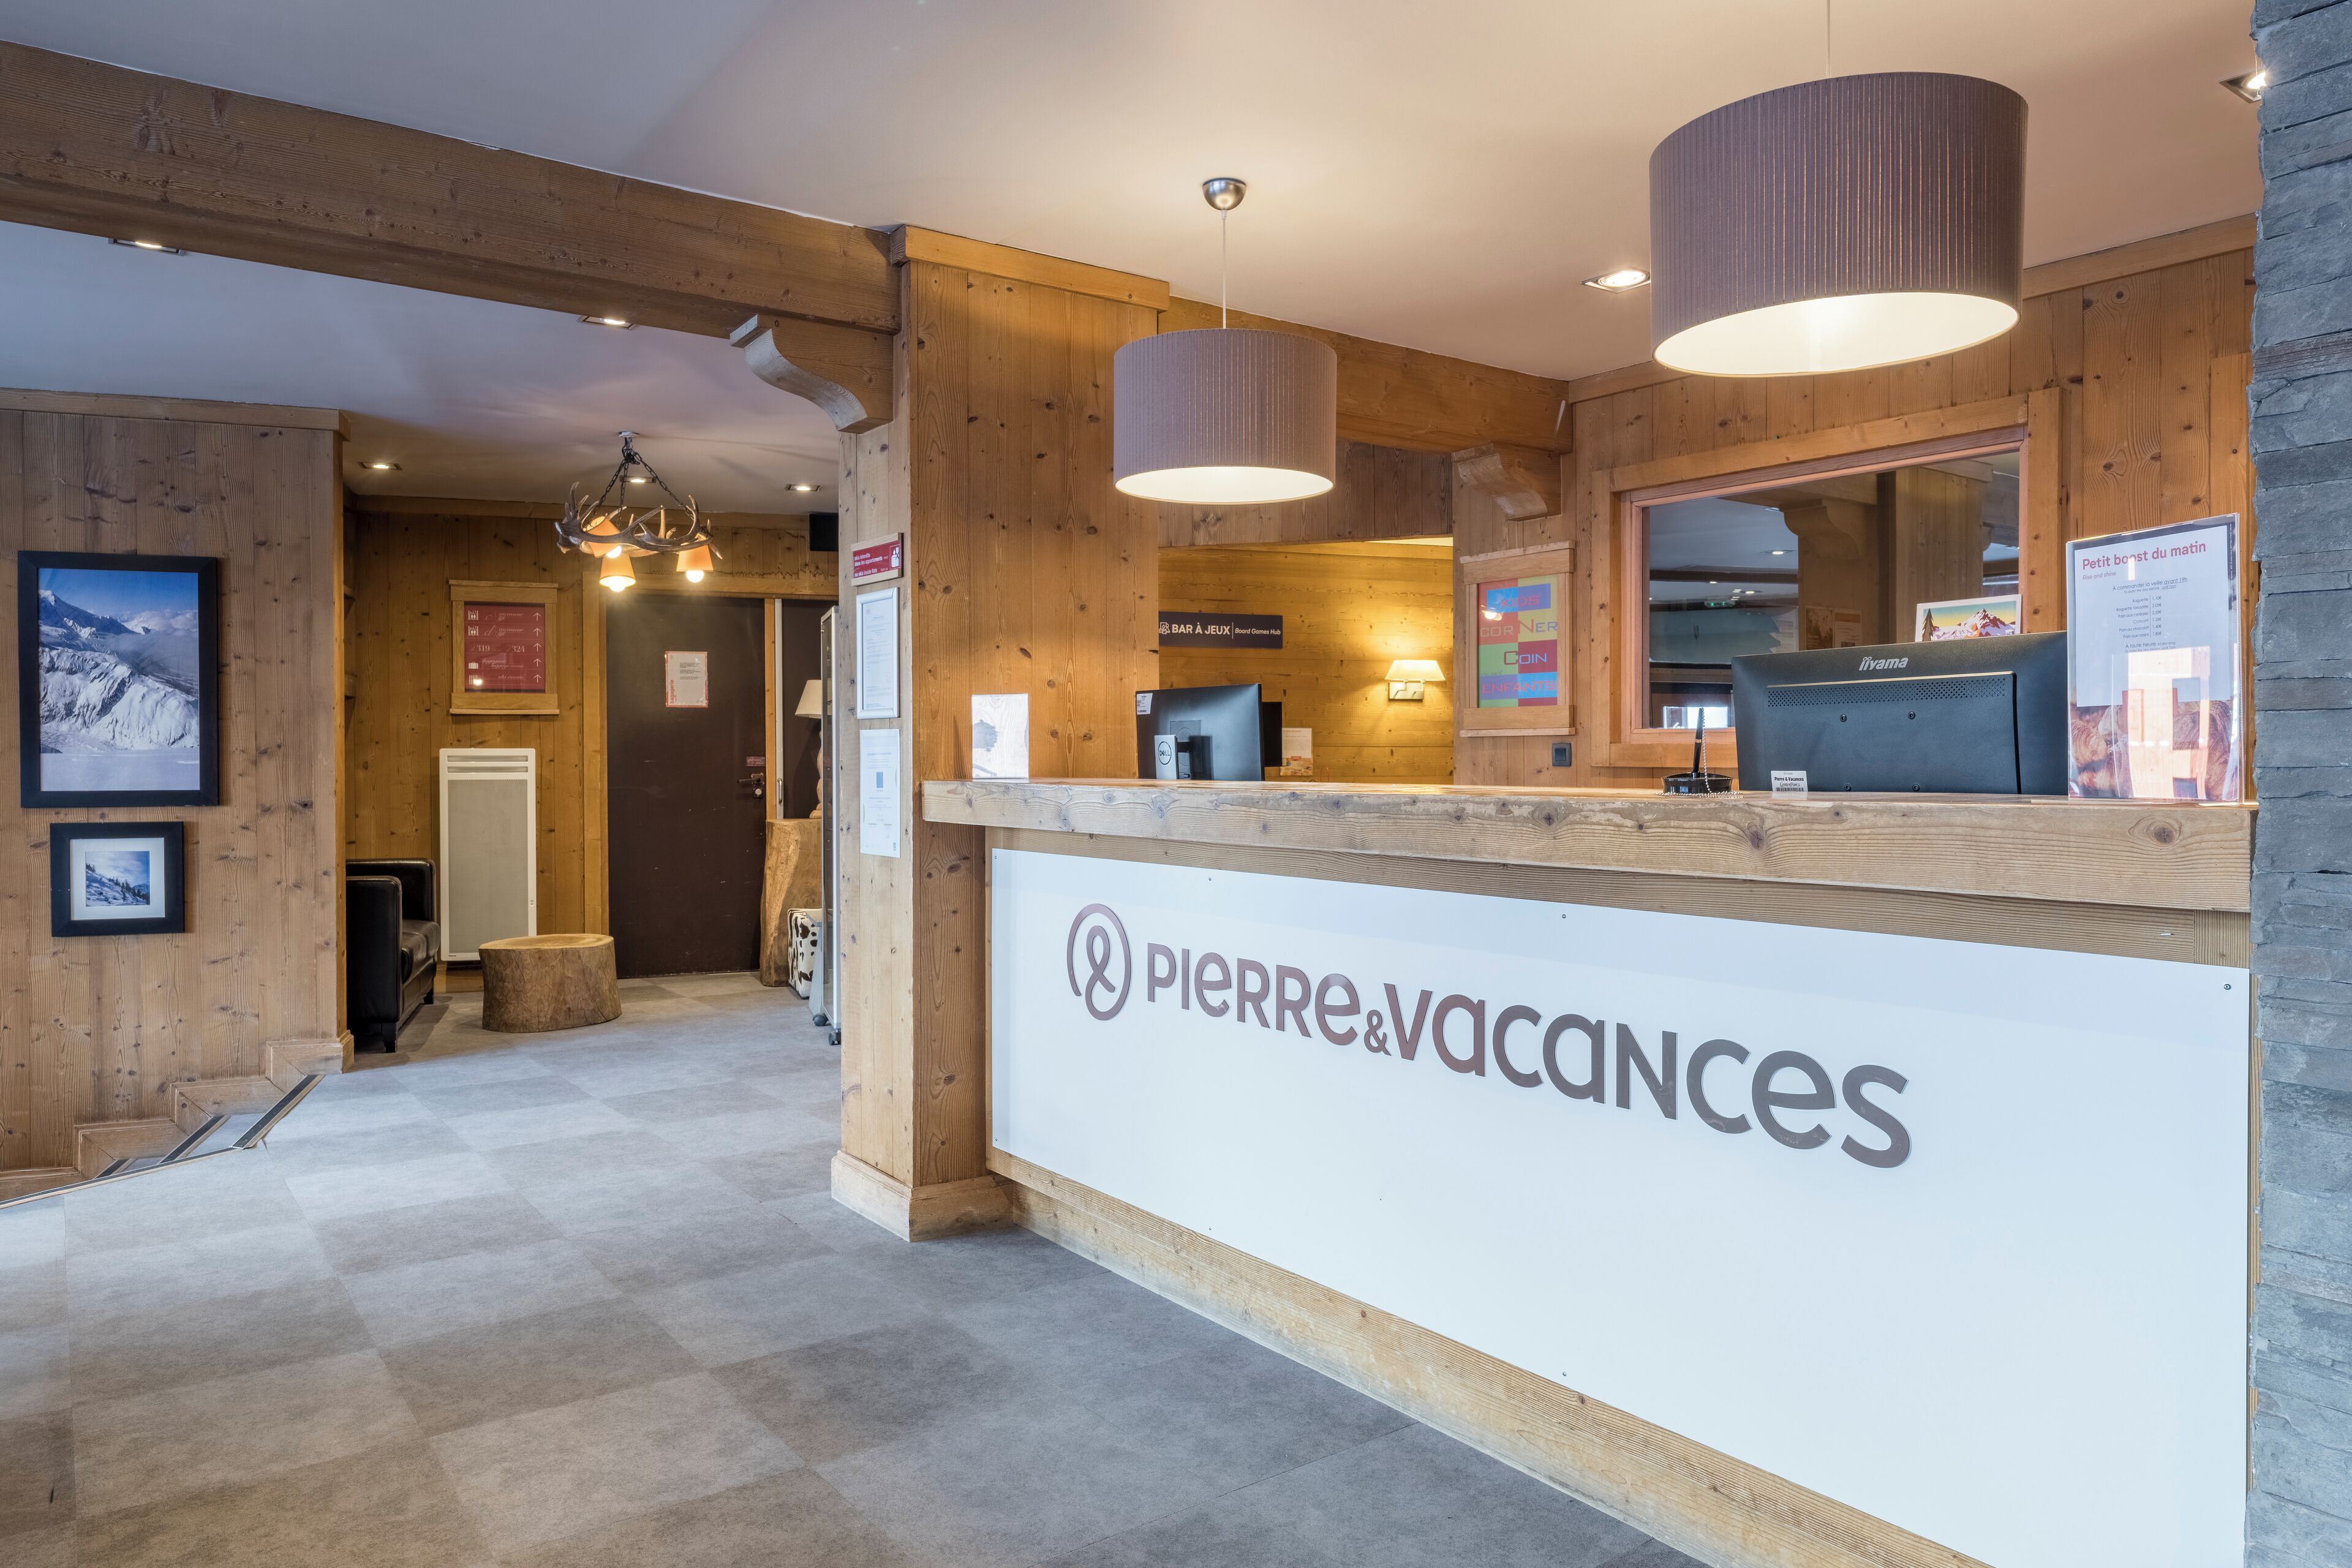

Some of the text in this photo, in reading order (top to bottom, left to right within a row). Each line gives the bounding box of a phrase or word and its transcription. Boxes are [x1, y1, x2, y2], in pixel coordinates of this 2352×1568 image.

[2082, 556, 2111, 570] Petit
[2152, 548, 2166, 559] du
[2171, 541, 2206, 557] matin
[1172, 624, 1193, 633] BAR
[1195, 622, 1203, 634] À
[1205, 625, 1231, 635] JEUX
[1504, 650, 1547, 665] COIN
[1859, 657, 1909, 671] iiyama
[1482, 680, 1557, 693] ENFANTS
